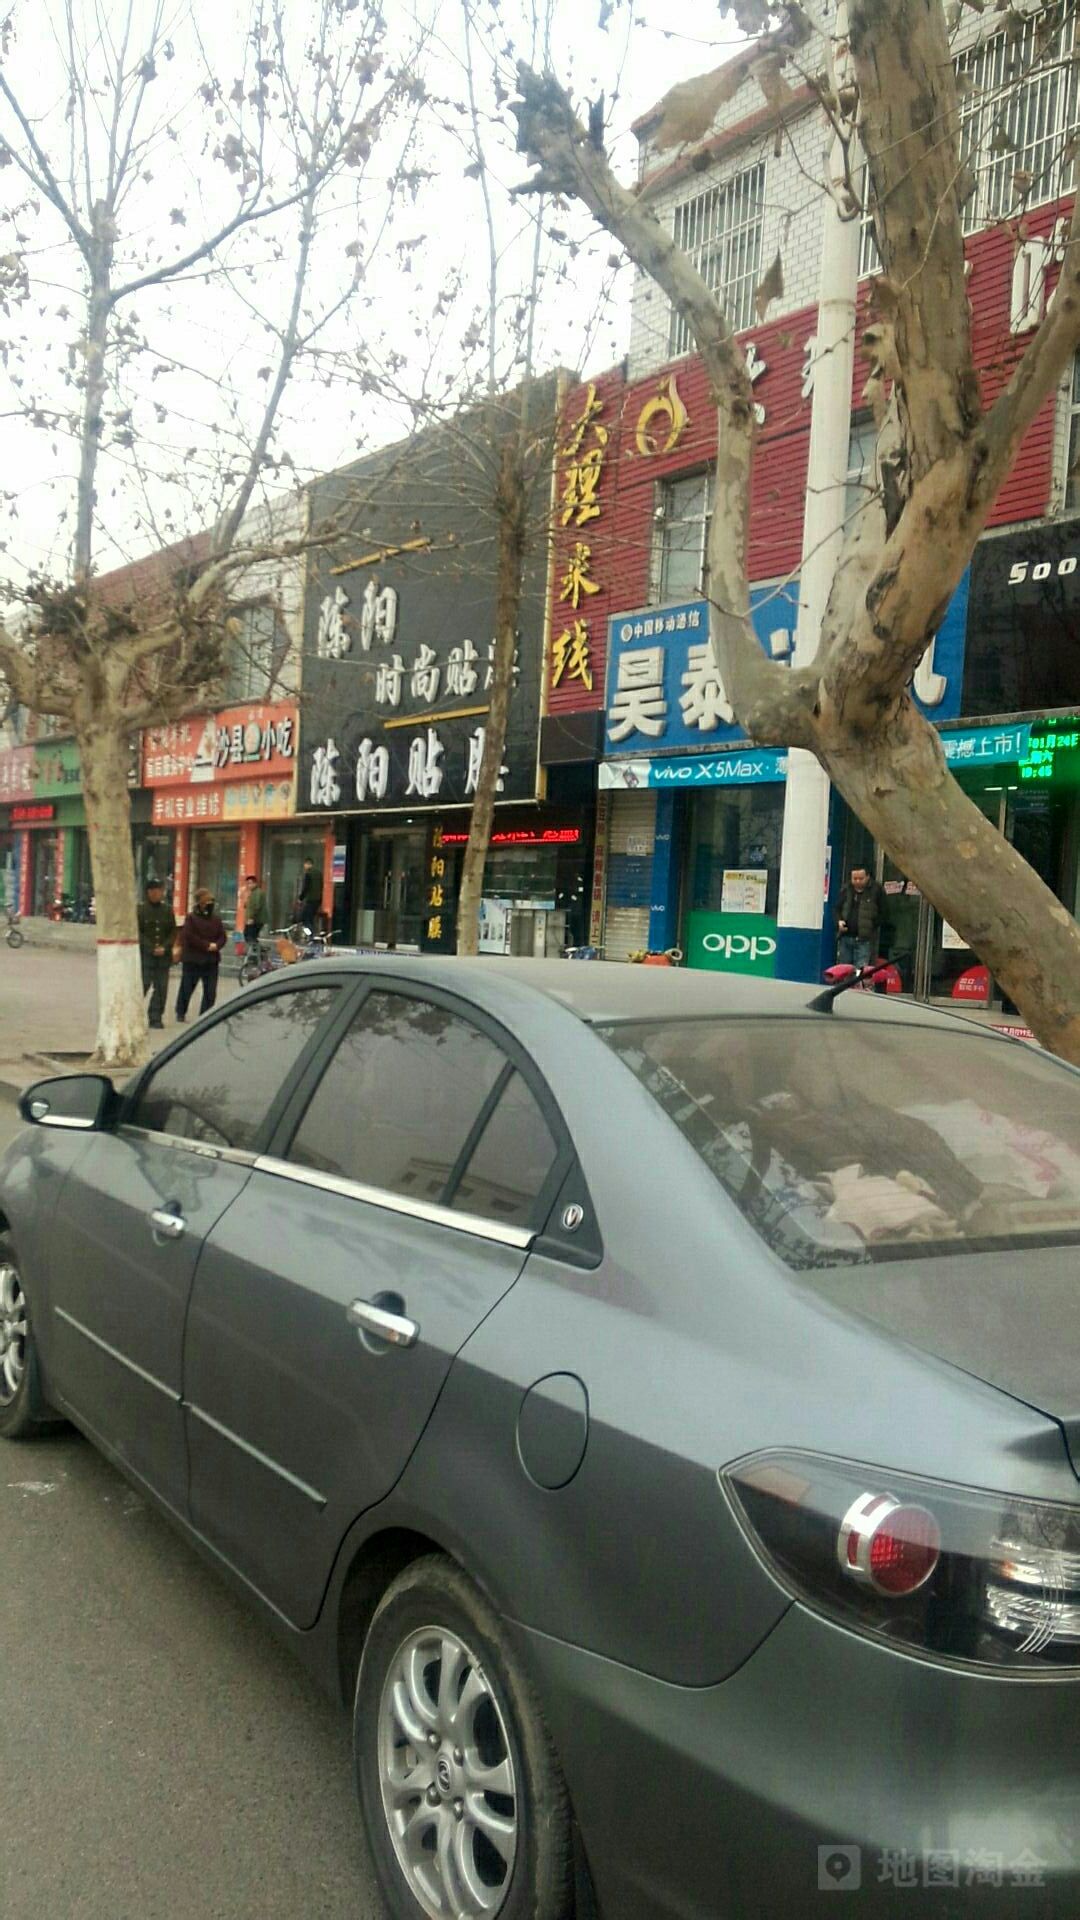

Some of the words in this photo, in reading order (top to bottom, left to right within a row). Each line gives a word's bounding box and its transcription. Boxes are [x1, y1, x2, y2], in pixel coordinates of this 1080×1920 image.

[633, 609, 701, 639] 中国移动通信
[214, 716, 294, 768] 沙县小吃
[654, 766, 692, 780] vivo
[154, 791, 220, 820] 手机专业维修
